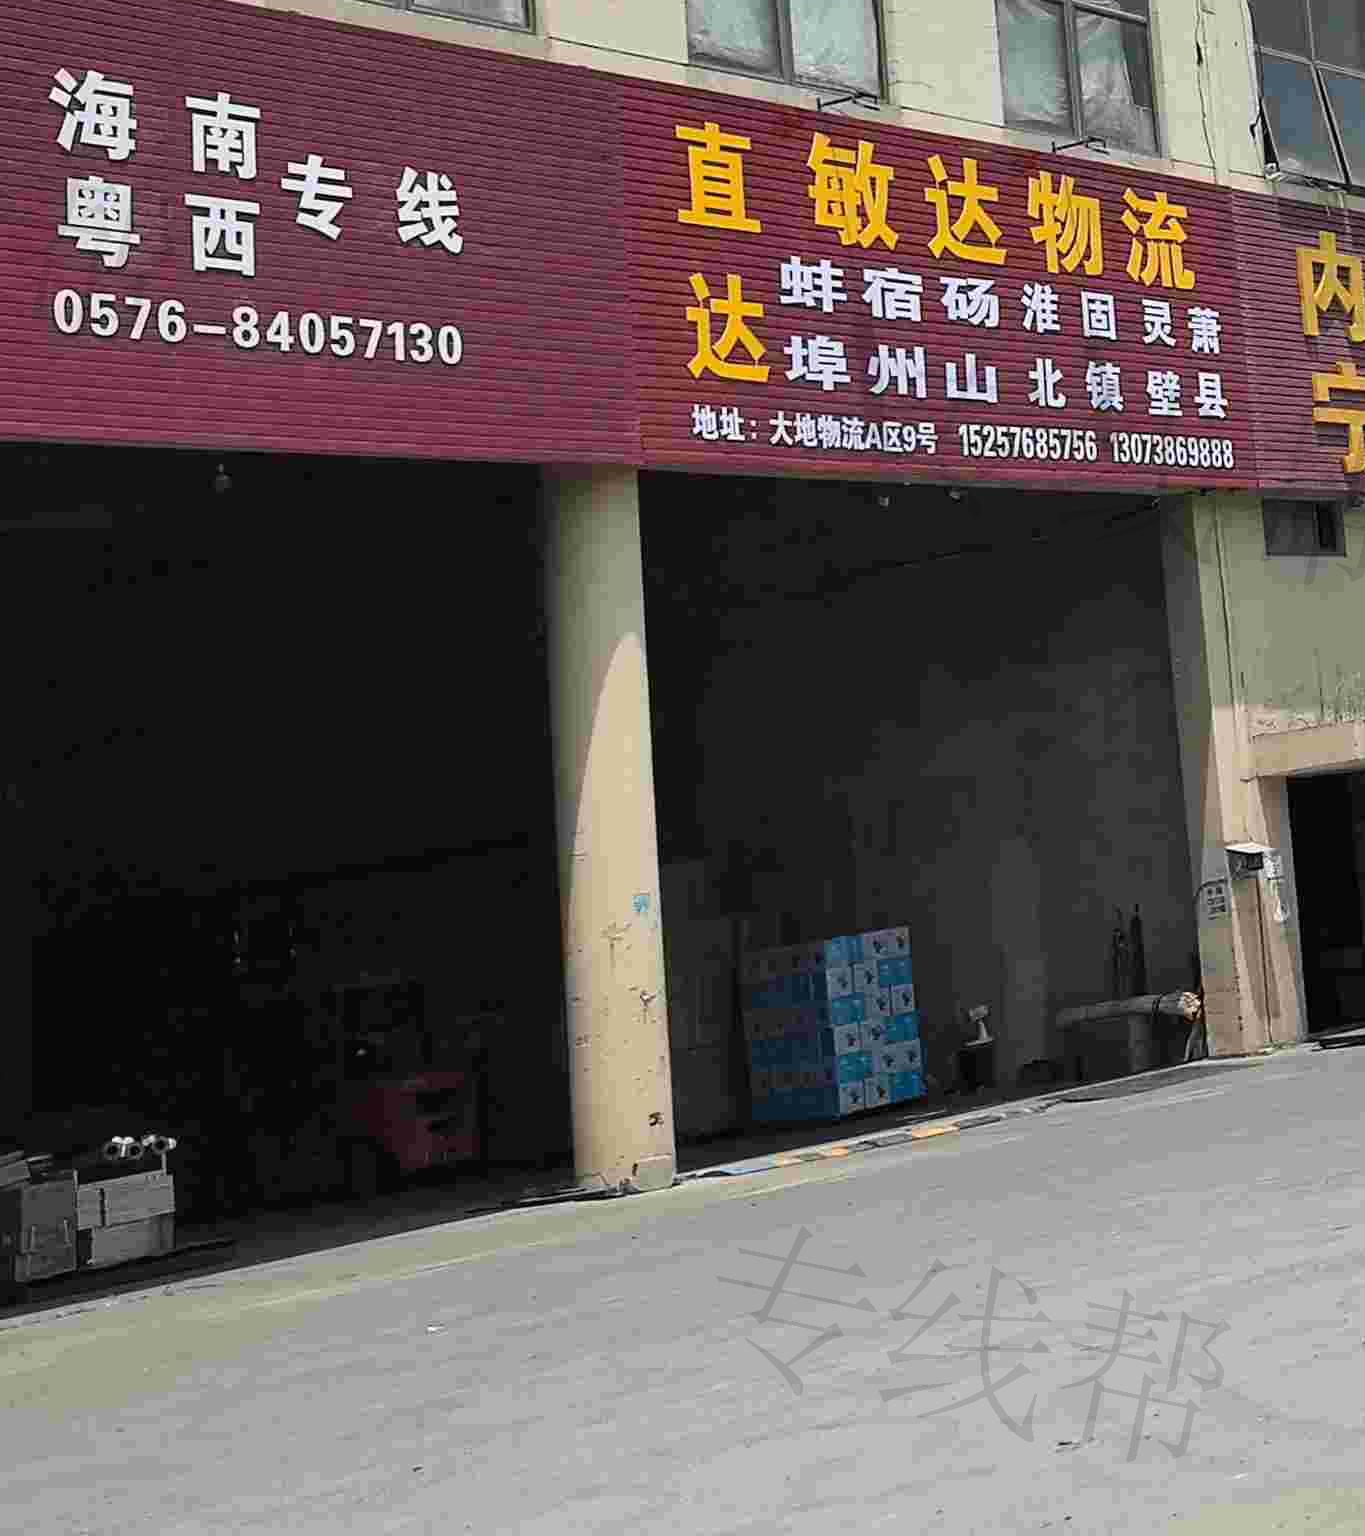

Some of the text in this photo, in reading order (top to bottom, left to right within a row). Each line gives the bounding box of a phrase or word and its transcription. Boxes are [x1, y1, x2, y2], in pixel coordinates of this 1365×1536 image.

[48, 67, 261, 180] 海南
[280, 153, 464, 255] 专线
[53, 288, 465, 366] 0576-84057130
[958, 423, 1098, 462] 15257685756
[1110, 431, 1234, 470] 13073869888
